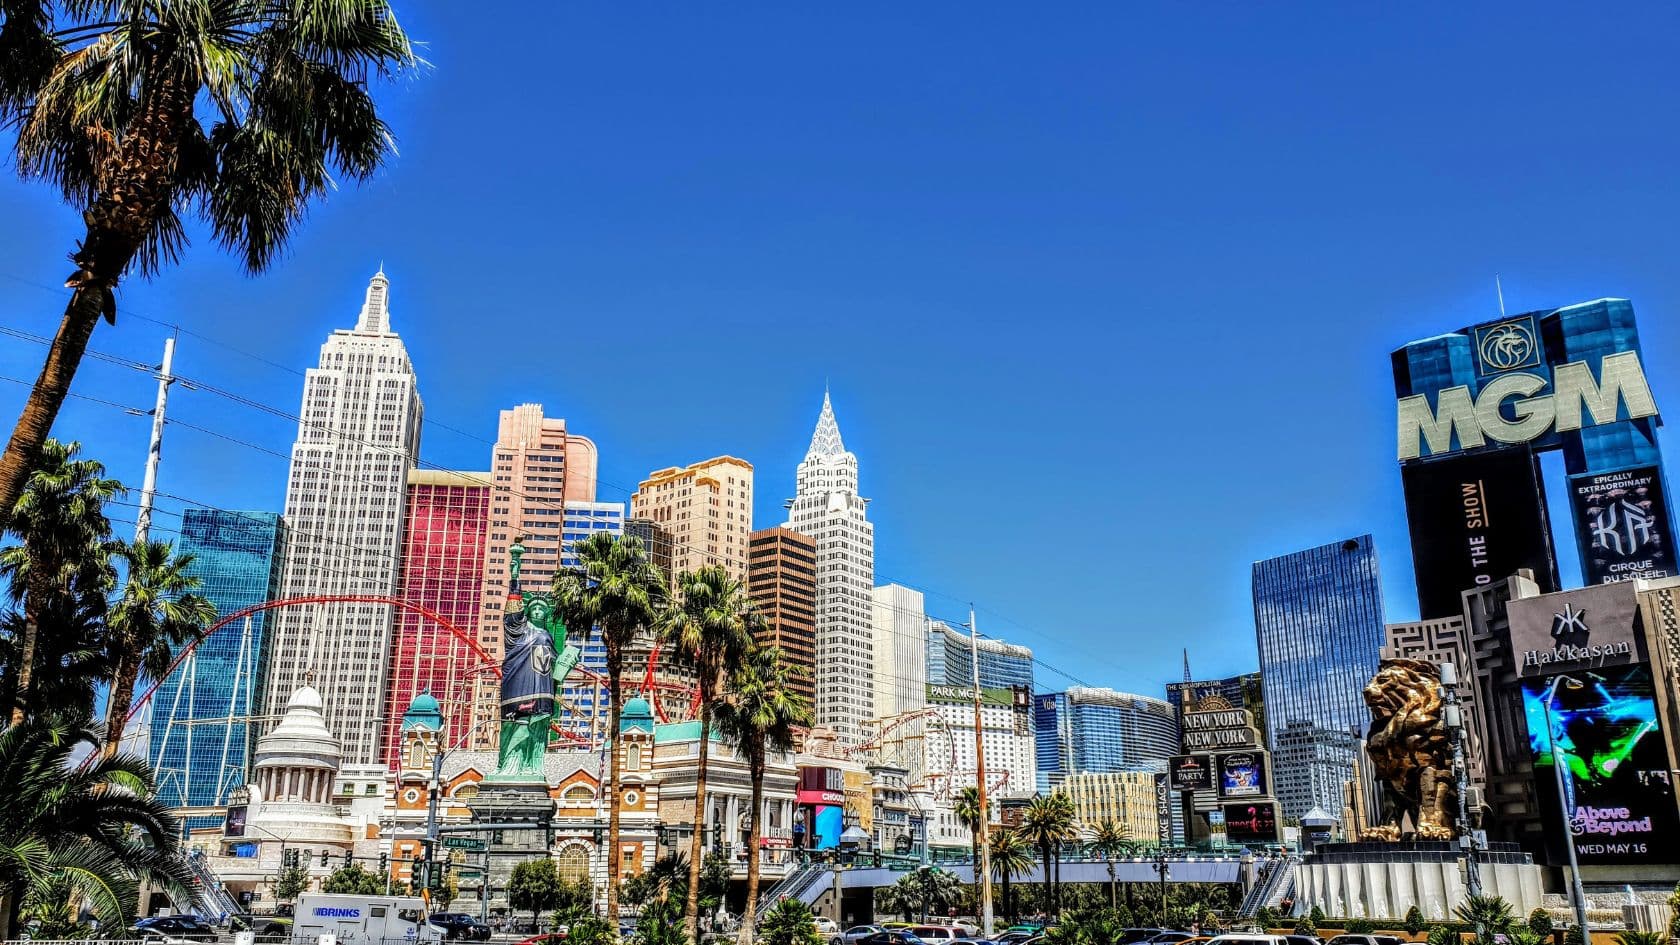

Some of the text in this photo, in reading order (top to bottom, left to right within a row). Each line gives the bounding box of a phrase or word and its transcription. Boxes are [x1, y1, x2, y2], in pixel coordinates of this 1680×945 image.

[1398, 350, 1658, 461] MGM
[1578, 477, 1652, 494] EXTRAORDINARY
[1594, 473, 1632, 484] EPICALLY
[1461, 483, 1482, 529] SHOW
[1469, 535, 1488, 568] THE
[1609, 560, 1653, 573] CIRQUE
[1603, 570, 1667, 585] DU SOLEIL
[1524, 641, 1630, 666] Hakkasan
[931, 686, 956, 699] PARK
[1167, 684, 1177, 692] THE
[1184, 711, 1245, 729] NEW YORK
[1185, 729, 1246, 747] NEW YORK
[1157, 781, 1168, 816] SHACK
[1575, 806, 1630, 821] Above
[1568, 816, 1652, 836] & Beyond
[1578, 843, 1648, 855] WED MAY 16
[320, 907, 360, 918] BRINKS
